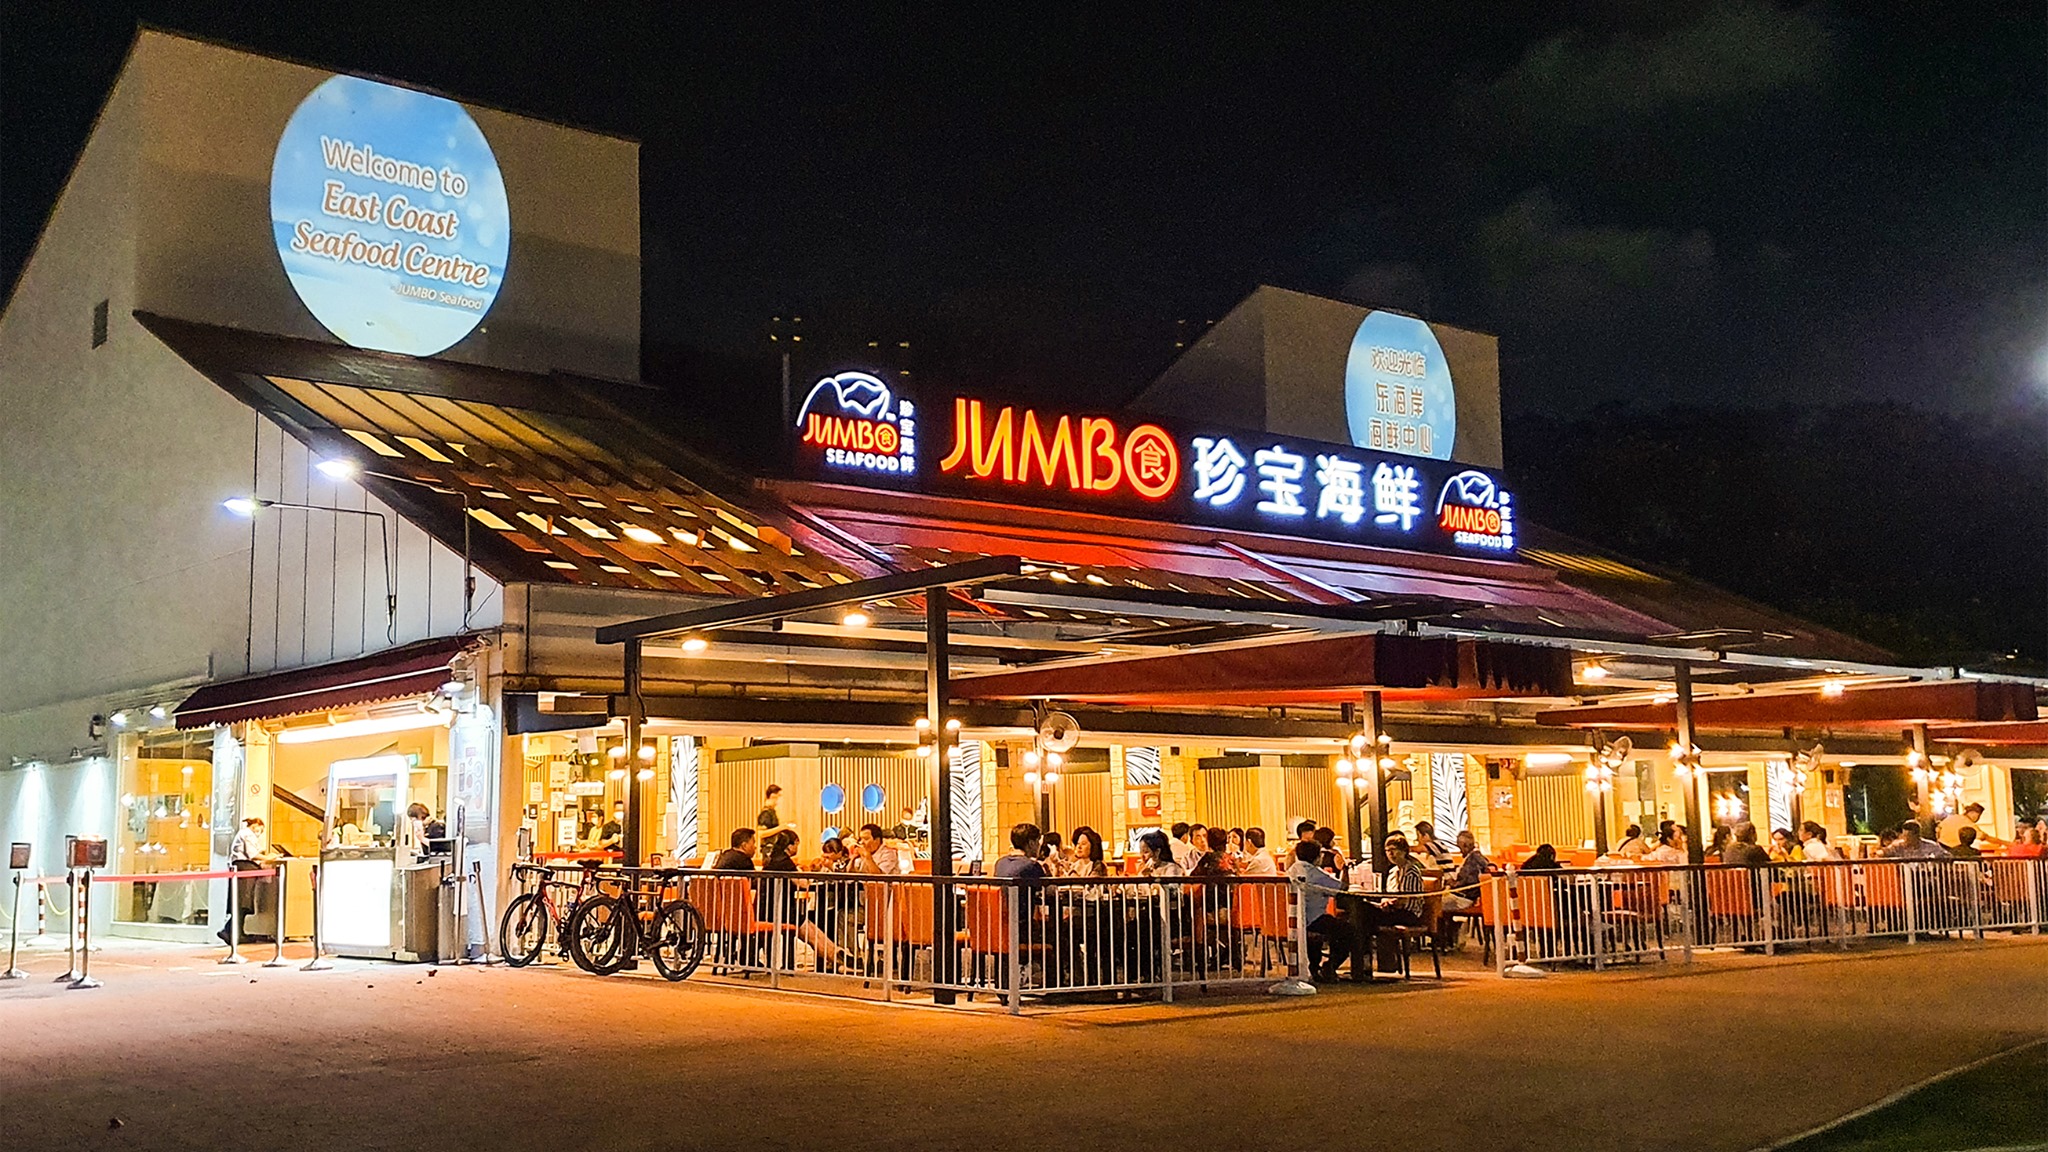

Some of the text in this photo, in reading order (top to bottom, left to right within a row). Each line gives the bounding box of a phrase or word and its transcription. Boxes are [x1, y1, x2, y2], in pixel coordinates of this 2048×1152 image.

[321, 137, 466, 196] Welcome to
[324, 183, 457, 237] East Coast
[293, 222, 488, 285] Seafood Centre
[396, 283, 483, 310] JUMBO Seafood
[1371, 348, 1426, 377] 欢迎光临
[1375, 382, 1423, 417] 东海岸
[803, 413, 898, 453] JUMBO
[940, 397, 1179, 499] JUMBO
[1370, 419, 1432, 453] 海鲜中心
[826, 448, 899, 471] SEAFOOD
[1192, 436, 1421, 531] 珍宝海鲜
[1440, 504, 1501, 534] JUMBO
[1454, 530, 1503, 548] SEAFOOD
